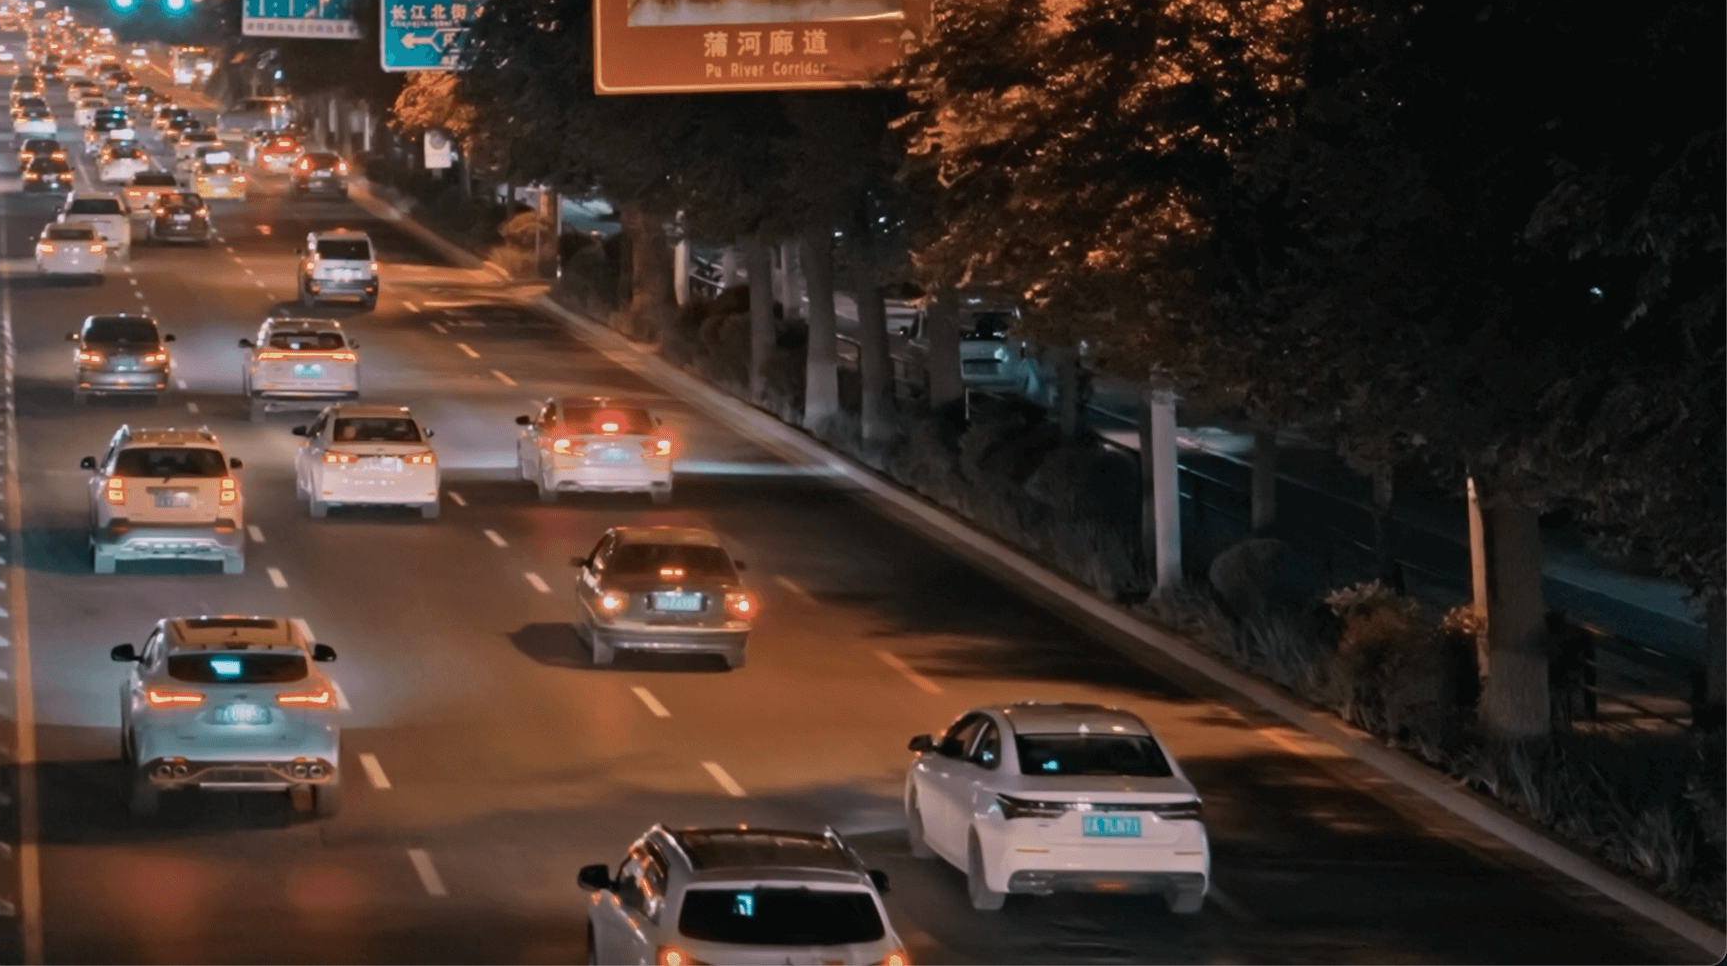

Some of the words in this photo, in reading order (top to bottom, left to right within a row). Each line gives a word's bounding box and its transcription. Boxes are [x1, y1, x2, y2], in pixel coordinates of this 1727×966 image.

[704, 30, 828, 57] 蒲河廊道
[705, 63, 722, 78] Pu
[730, 62, 766, 77] River
[772, 60, 826, 76] Corridor
